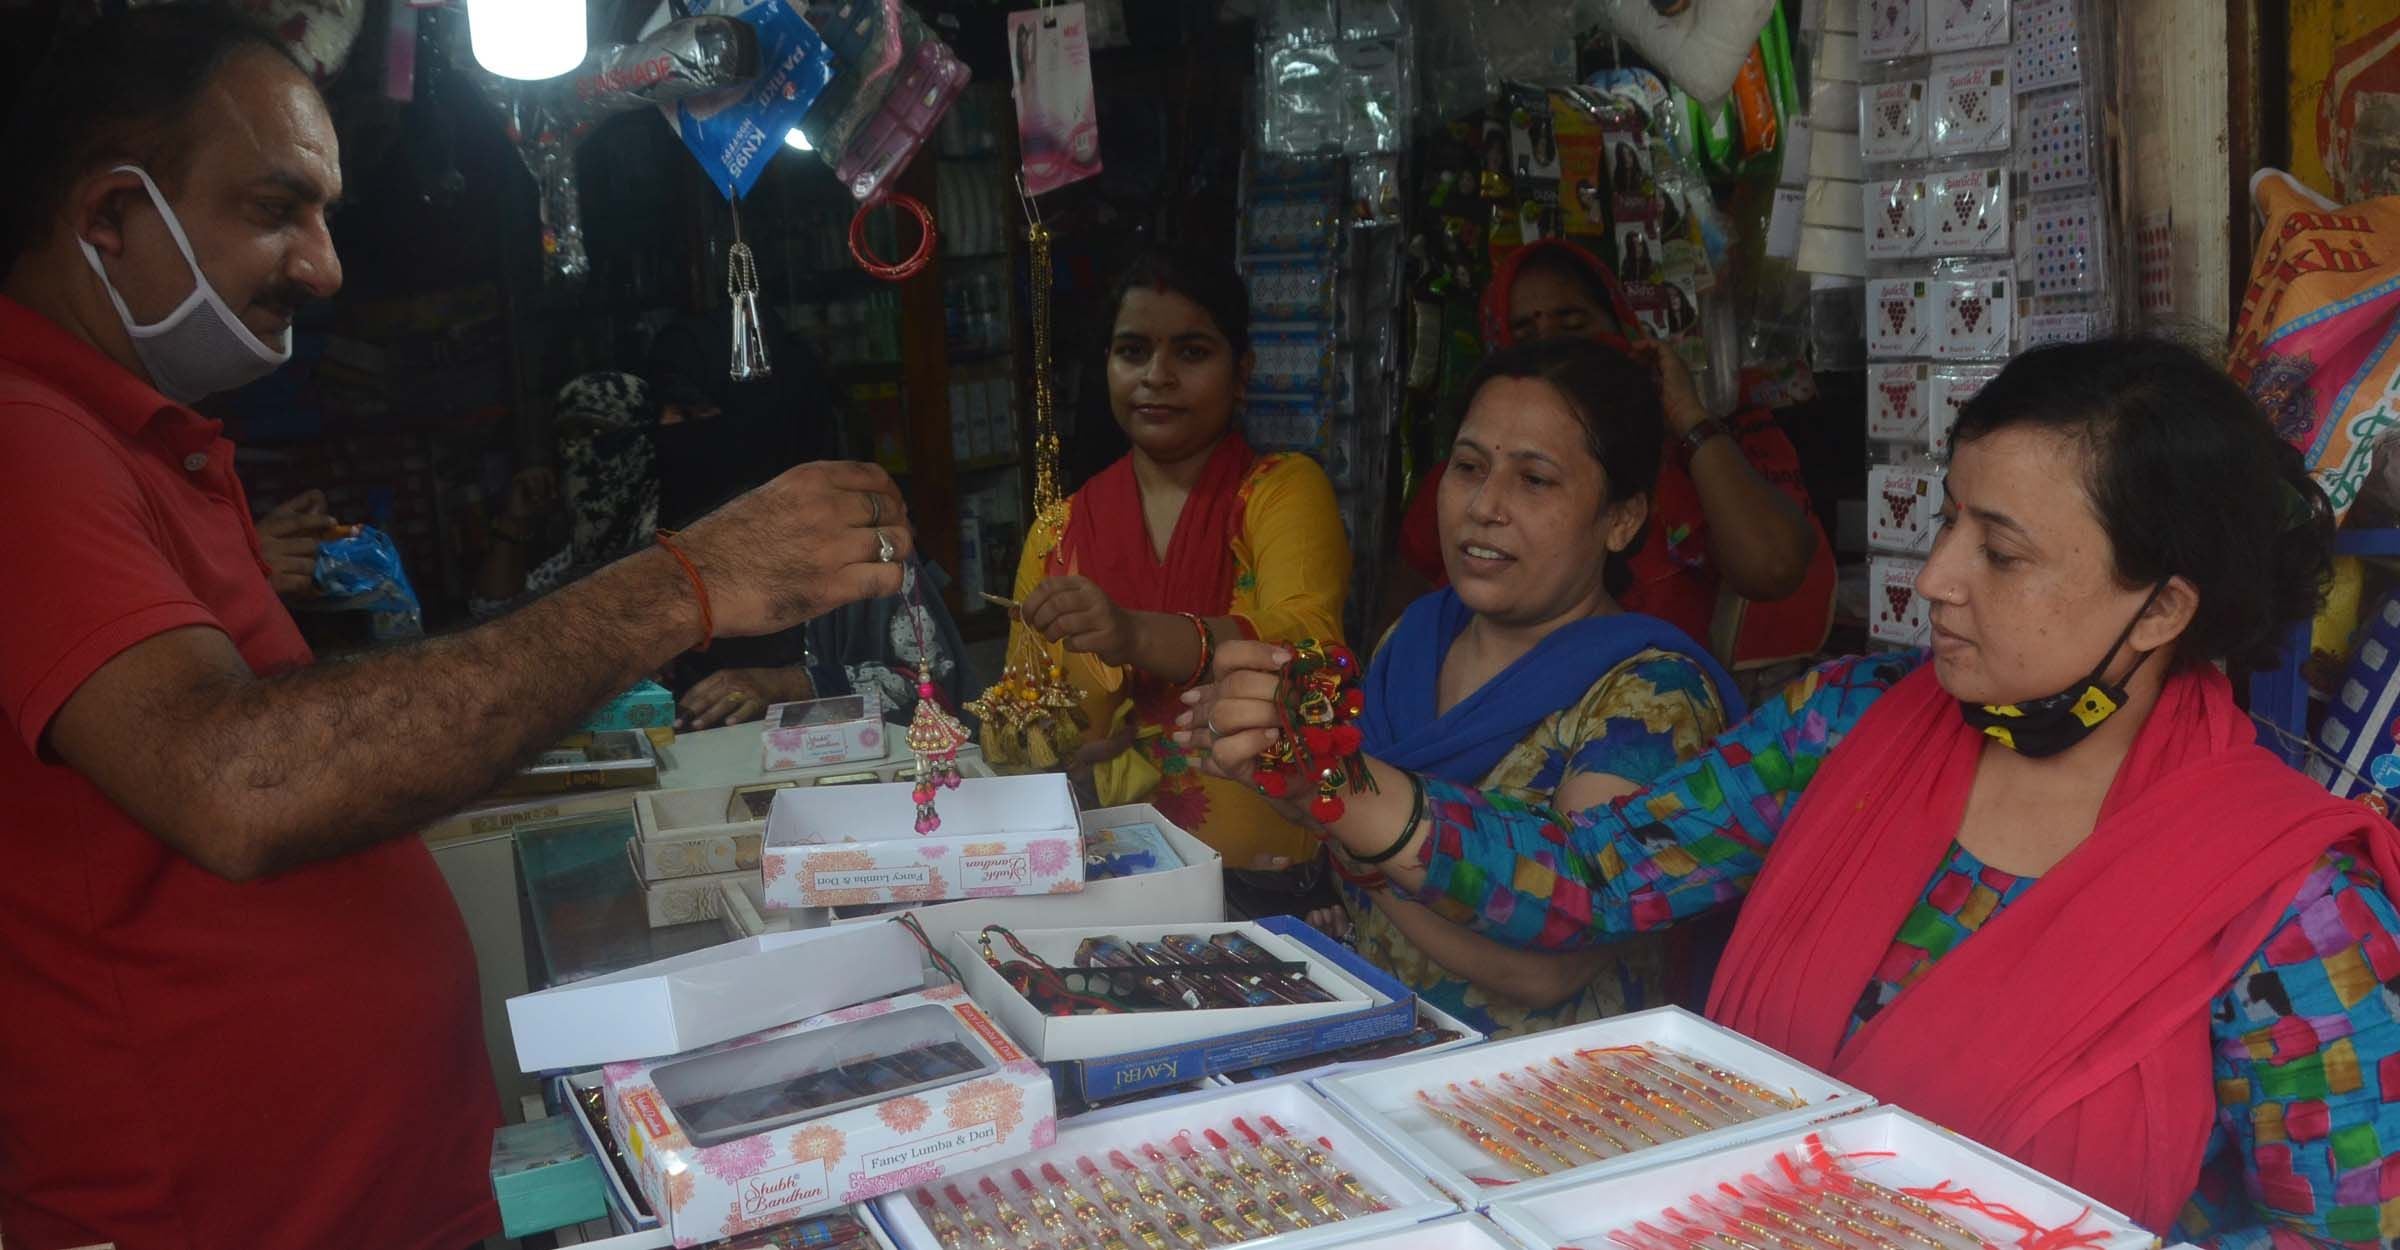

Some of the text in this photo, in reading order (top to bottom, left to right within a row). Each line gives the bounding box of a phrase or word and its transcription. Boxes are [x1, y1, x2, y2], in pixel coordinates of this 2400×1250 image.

[729, 126, 765, 178] KN95
[816, 872, 924, 886] Fancy Lumba & Dori
[1116, 1060, 1178, 1087] KAVERI
[871, 1126, 996, 1170] Fancy Lumba & Dori
[746, 1187, 822, 1213] Bandhan
